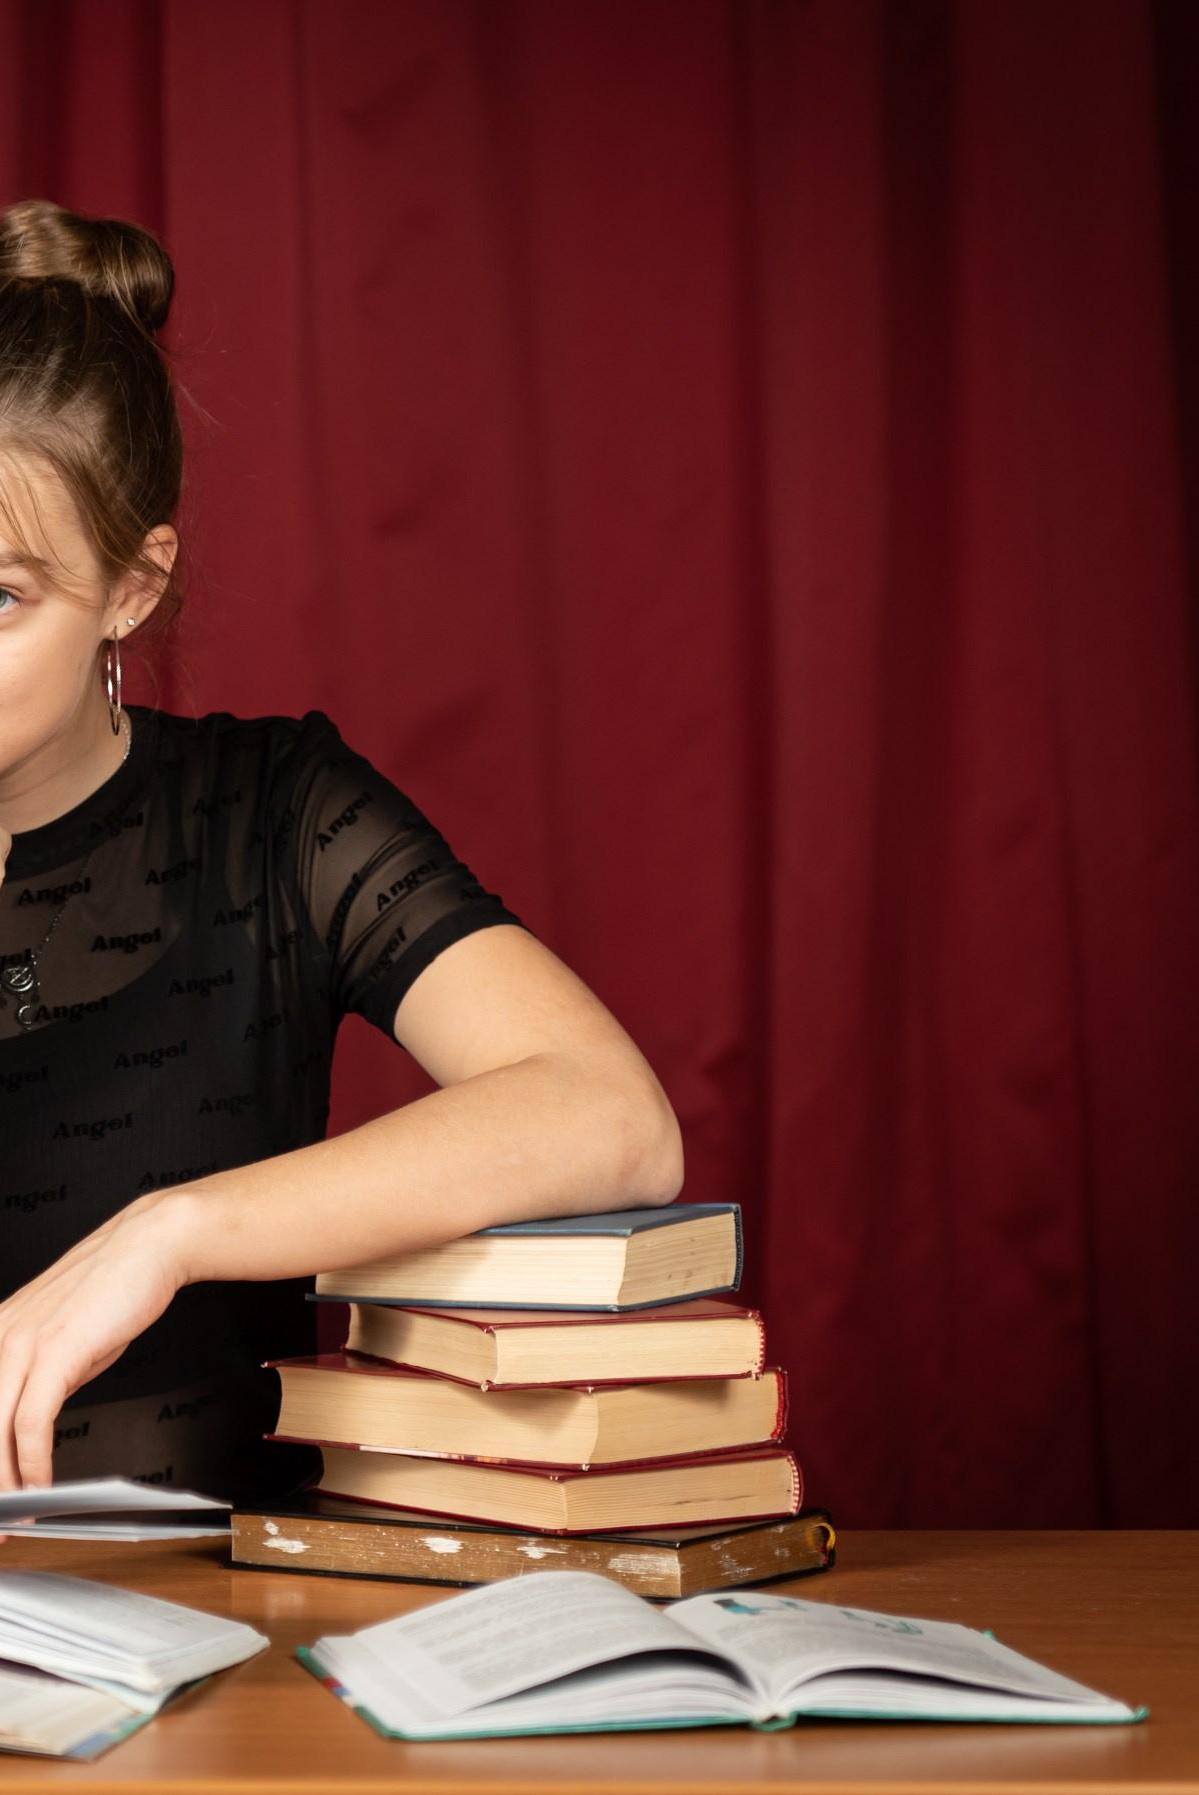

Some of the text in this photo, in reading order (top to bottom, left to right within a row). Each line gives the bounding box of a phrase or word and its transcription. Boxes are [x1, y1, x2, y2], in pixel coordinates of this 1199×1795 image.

[316, 791, 373, 851] Angel
[145, 857, 203, 885] Ange
[376, 859, 439, 911] Angel
[18, 878, 91, 905] Angel
[91, 927, 161, 954] Angel
[168, 969, 234, 997] Angel
[34, 996, 108, 1022] Angel
[114, 1040, 187, 1069] Angel
[53, 1113, 133, 1140] Angel
